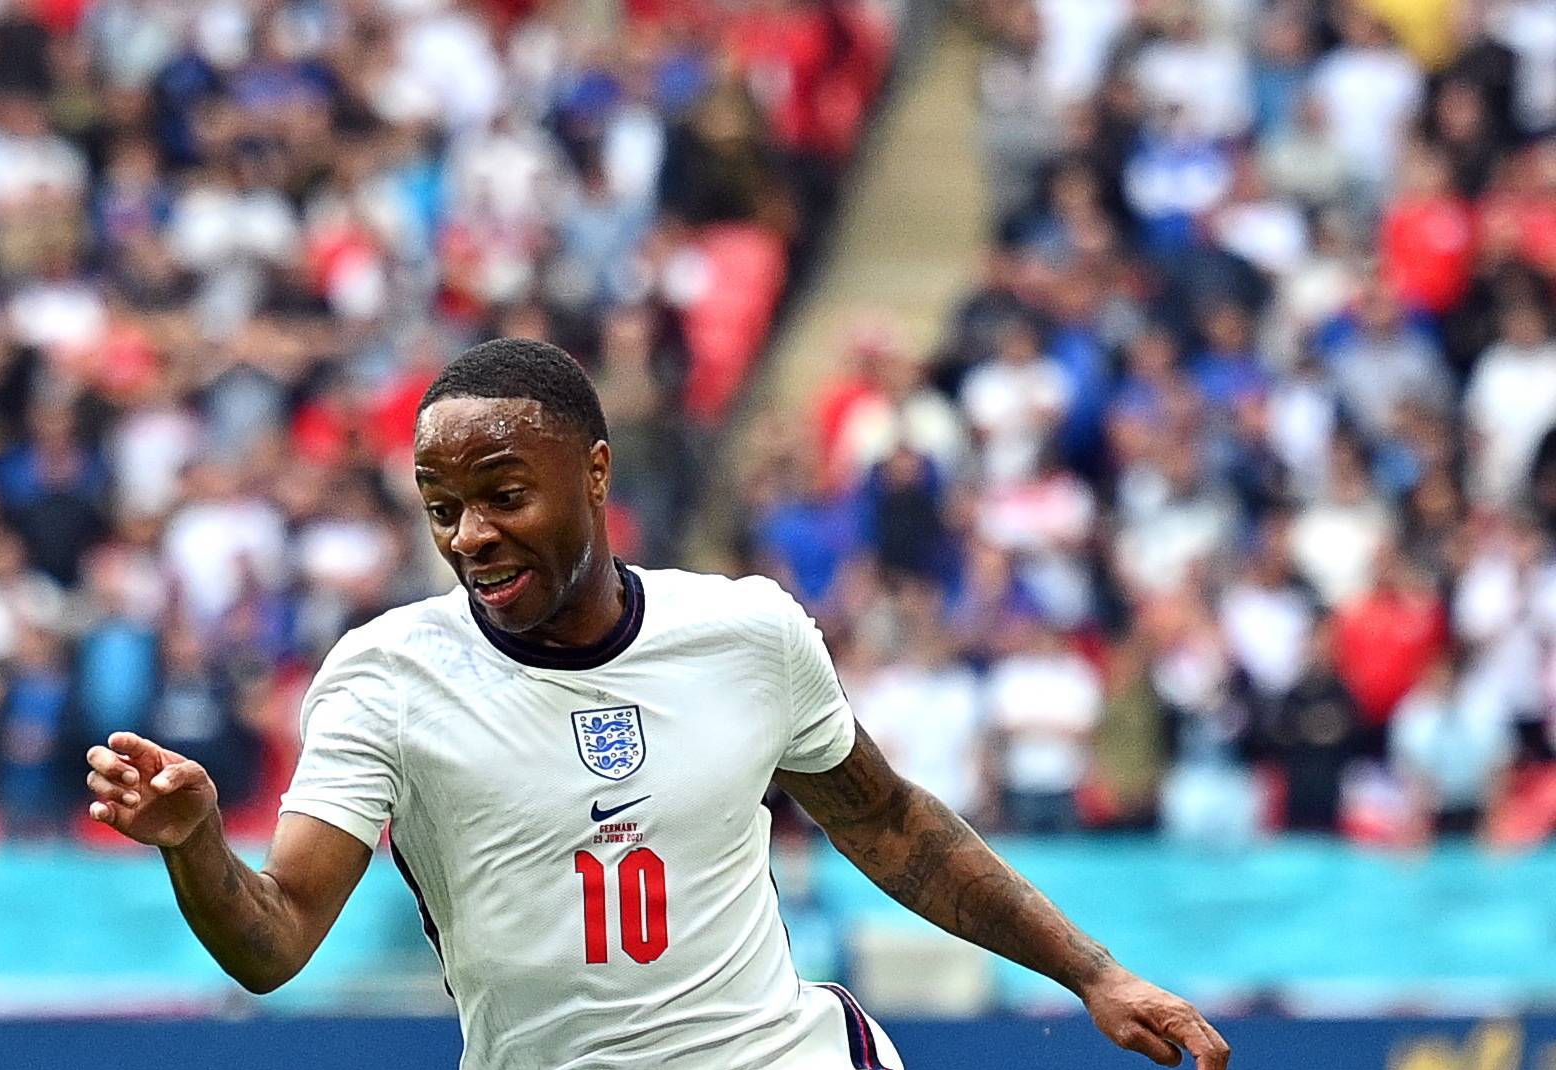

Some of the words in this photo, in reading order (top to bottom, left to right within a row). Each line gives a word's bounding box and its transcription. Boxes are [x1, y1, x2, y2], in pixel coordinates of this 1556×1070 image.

[599, 823, 638, 833] GERMANY
[604, 833, 625, 843] JUNE
[574, 847, 668, 964] 10
